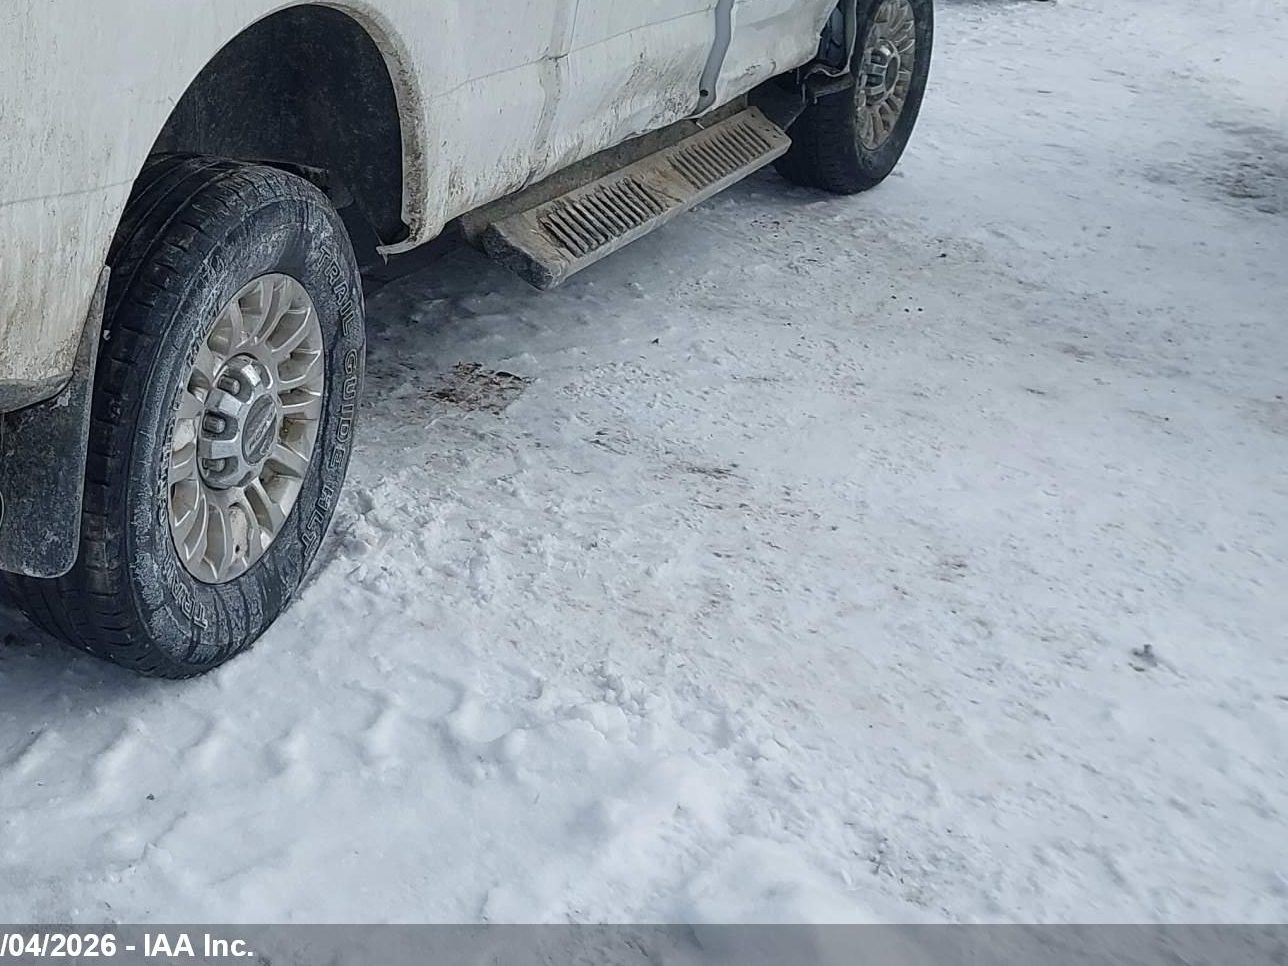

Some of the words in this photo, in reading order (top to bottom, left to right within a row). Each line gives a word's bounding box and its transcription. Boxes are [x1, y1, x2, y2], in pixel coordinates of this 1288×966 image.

[316, 245, 355, 337] TRAIL
[327, 348, 358, 470] GUIDE
[301, 484, 335, 556] HLT
